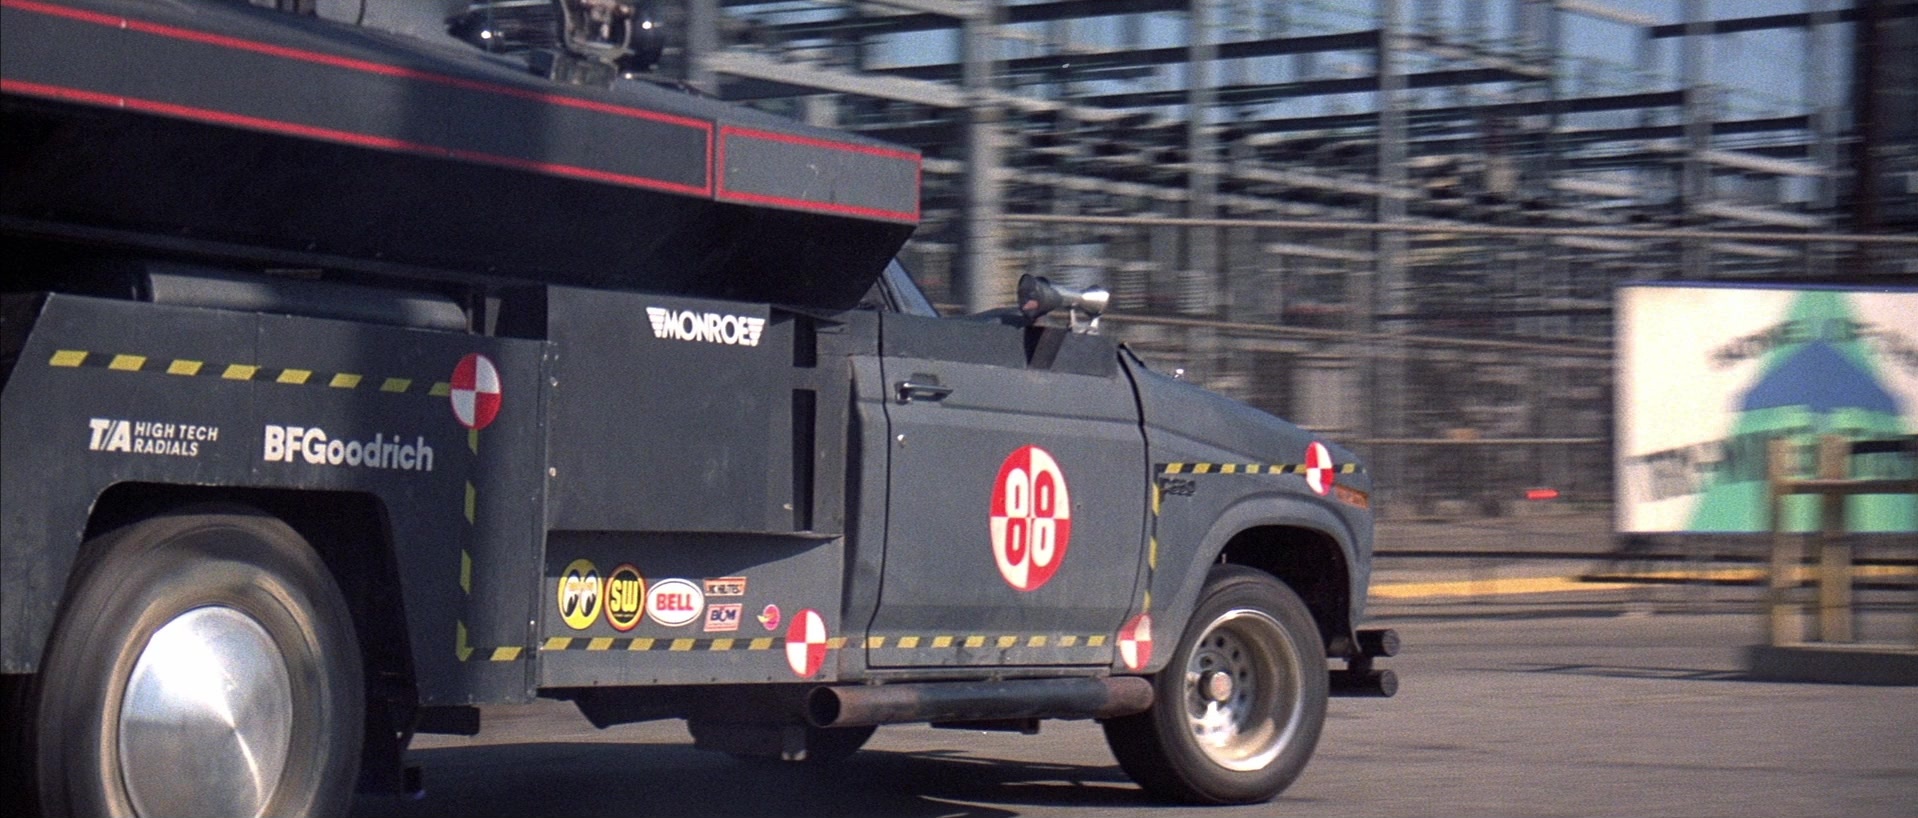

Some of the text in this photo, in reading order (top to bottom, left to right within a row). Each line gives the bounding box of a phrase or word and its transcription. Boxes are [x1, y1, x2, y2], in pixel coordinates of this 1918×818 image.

[661, 309, 752, 346] MONROE
[88, 418, 219, 453] T/A HIGH TECH
[134, 438, 199, 457] RADIALS
[264, 424, 434, 472] BFGoodrich
[1004, 467, 1056, 567] 88
[610, 579, 639, 613] SW
[656, 593, 694, 611] BELL
